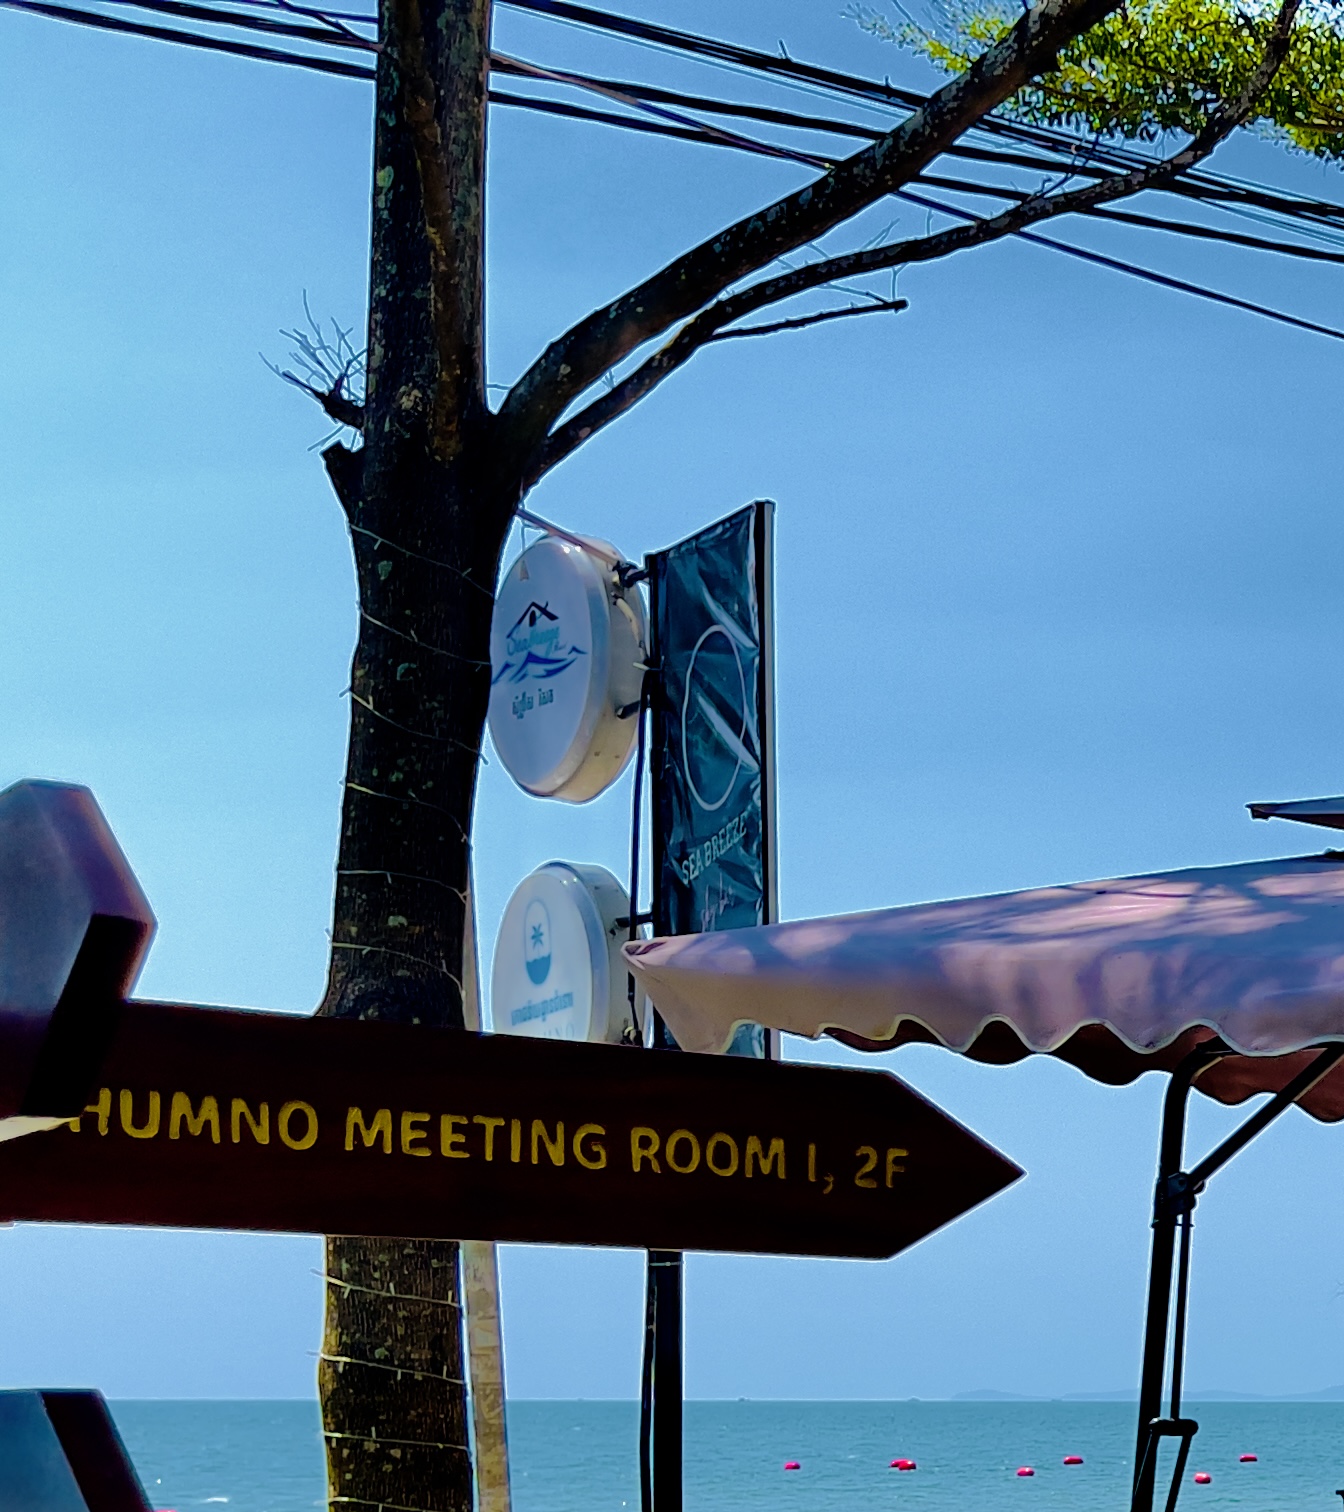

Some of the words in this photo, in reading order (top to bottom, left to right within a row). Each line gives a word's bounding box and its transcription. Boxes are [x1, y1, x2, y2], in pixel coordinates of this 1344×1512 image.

[682, 849, 704, 885] SEA
[704, 810, 747, 867] BREEZE
[344, 1107, 607, 1171] MEETING
[630, 1126, 786, 1179] ROOM
[854, 1145, 909, 1188] 2F
